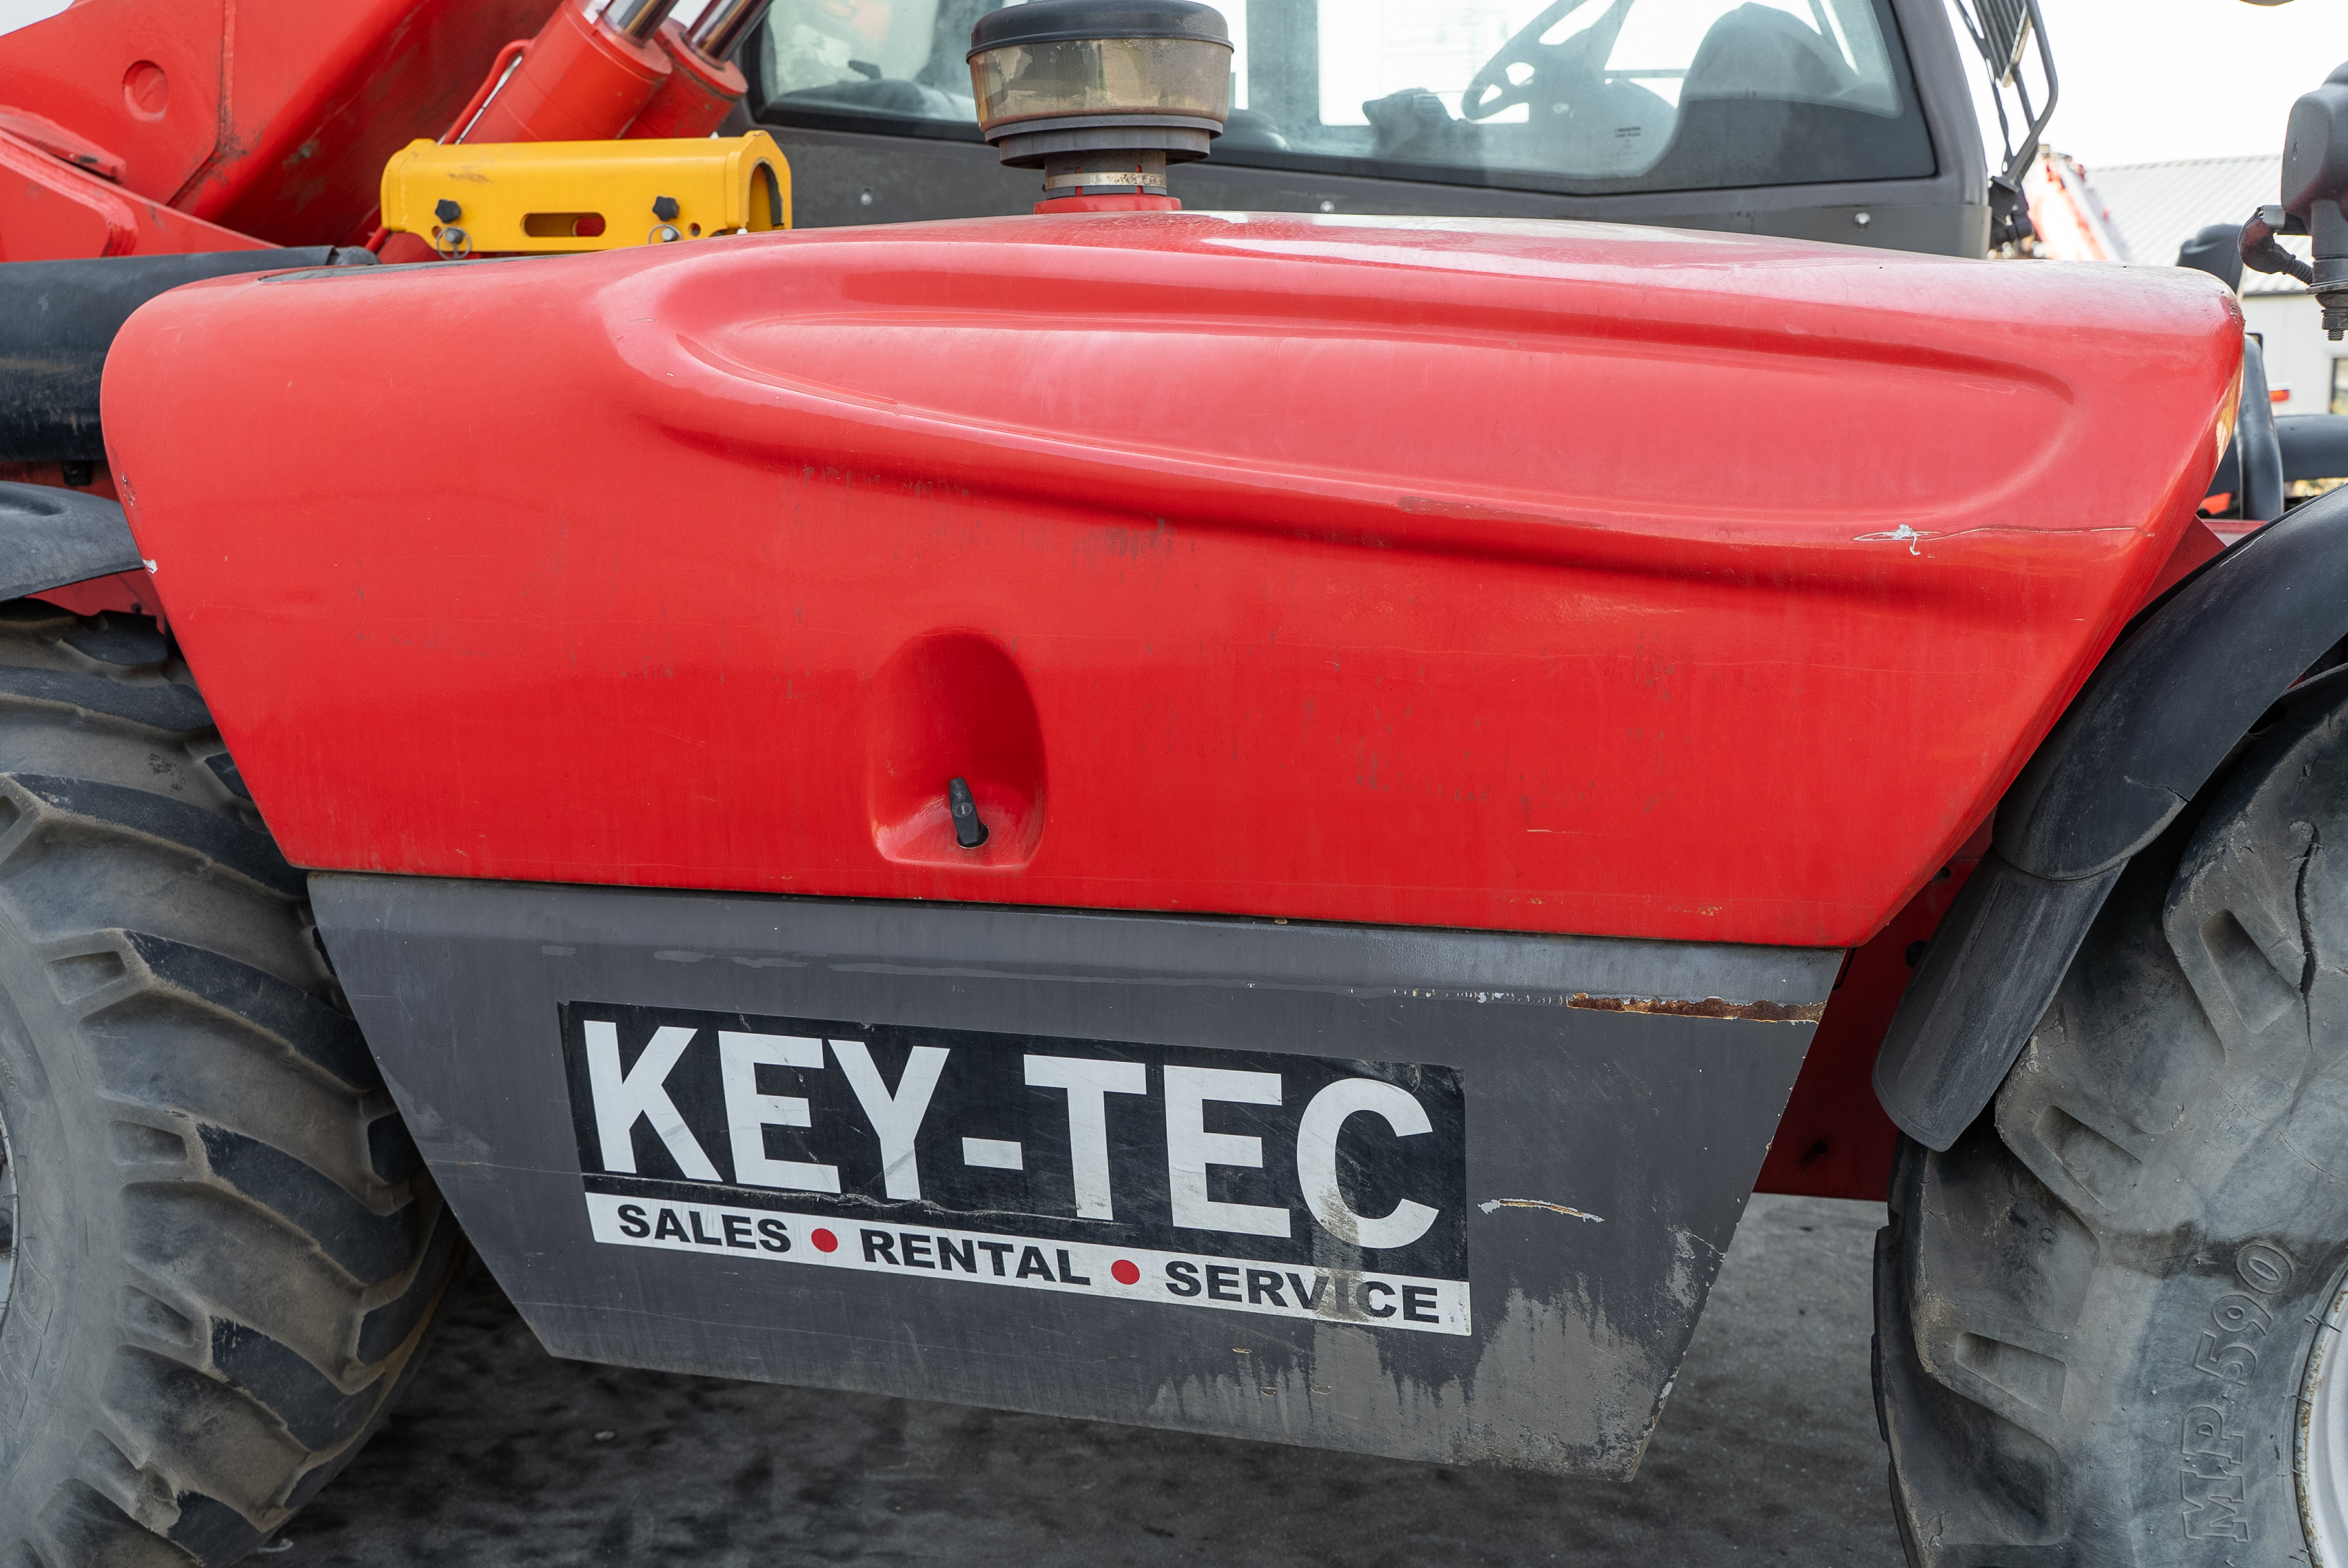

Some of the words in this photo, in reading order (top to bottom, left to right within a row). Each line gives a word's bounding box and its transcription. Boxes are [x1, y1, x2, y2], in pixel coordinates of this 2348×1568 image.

[584, 1020, 1440, 1249] KEY-TEC
[618, 1204, 792, 1252] SALES
[862, 1229, 1091, 1286] RENTAL
[1164, 1260, 1440, 1323] SERVICE
